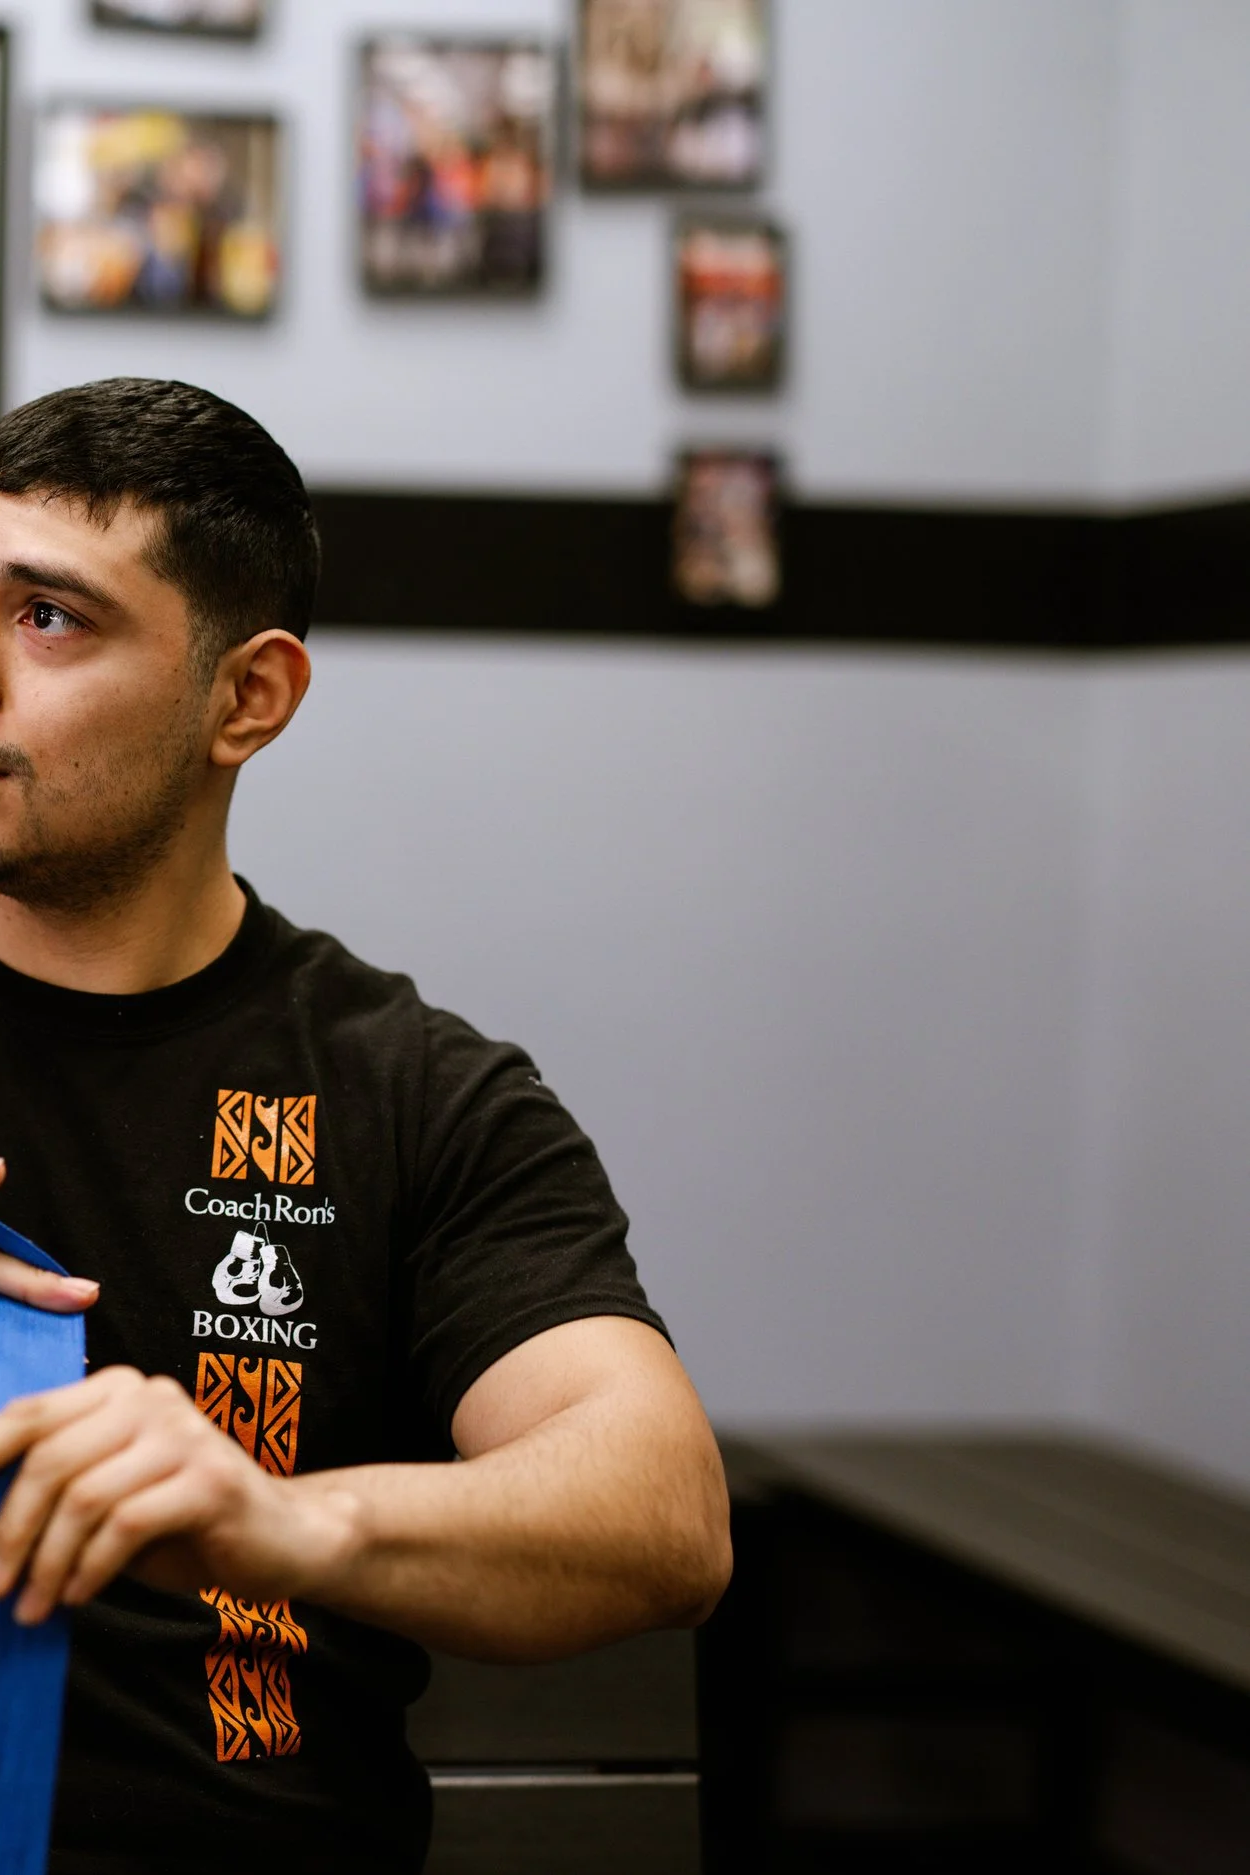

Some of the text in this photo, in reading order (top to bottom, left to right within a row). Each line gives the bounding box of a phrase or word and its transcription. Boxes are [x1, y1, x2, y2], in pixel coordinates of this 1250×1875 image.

[184, 1188, 335, 1225] Coach Ron's
[191, 1310, 317, 1349] BOXING
